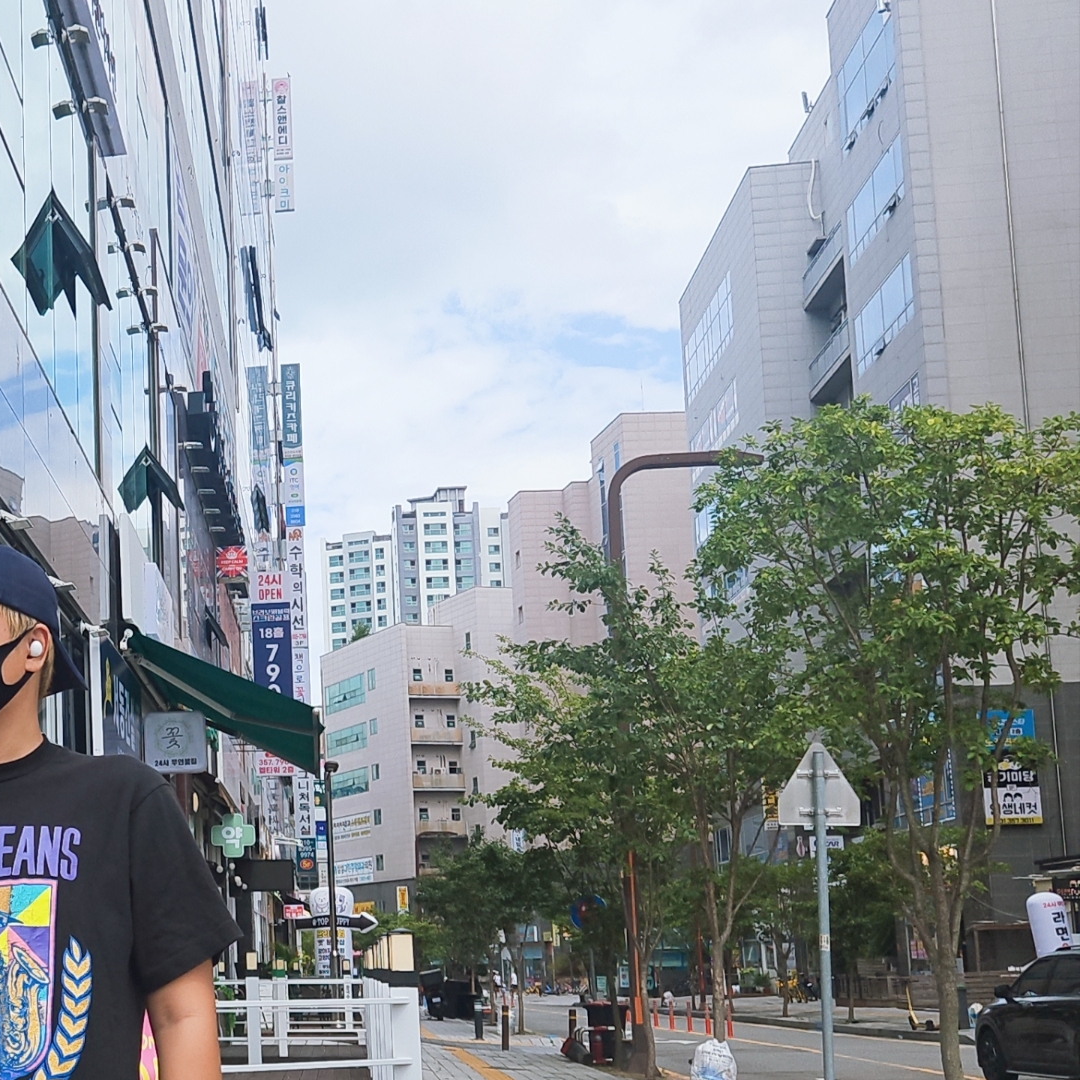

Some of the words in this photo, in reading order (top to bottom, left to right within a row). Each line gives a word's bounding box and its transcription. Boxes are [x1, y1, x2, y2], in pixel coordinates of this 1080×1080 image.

[258, 574, 282, 587] 24시
[258, 588, 282, 600] OPEN
[259, 627, 284, 639] 18홀
[162, 726, 183, 749] 꽃
[154, 759, 170, 767] 24시
[221, 826, 243, 849] 약
[1051, 911, 1070, 941] 라면
